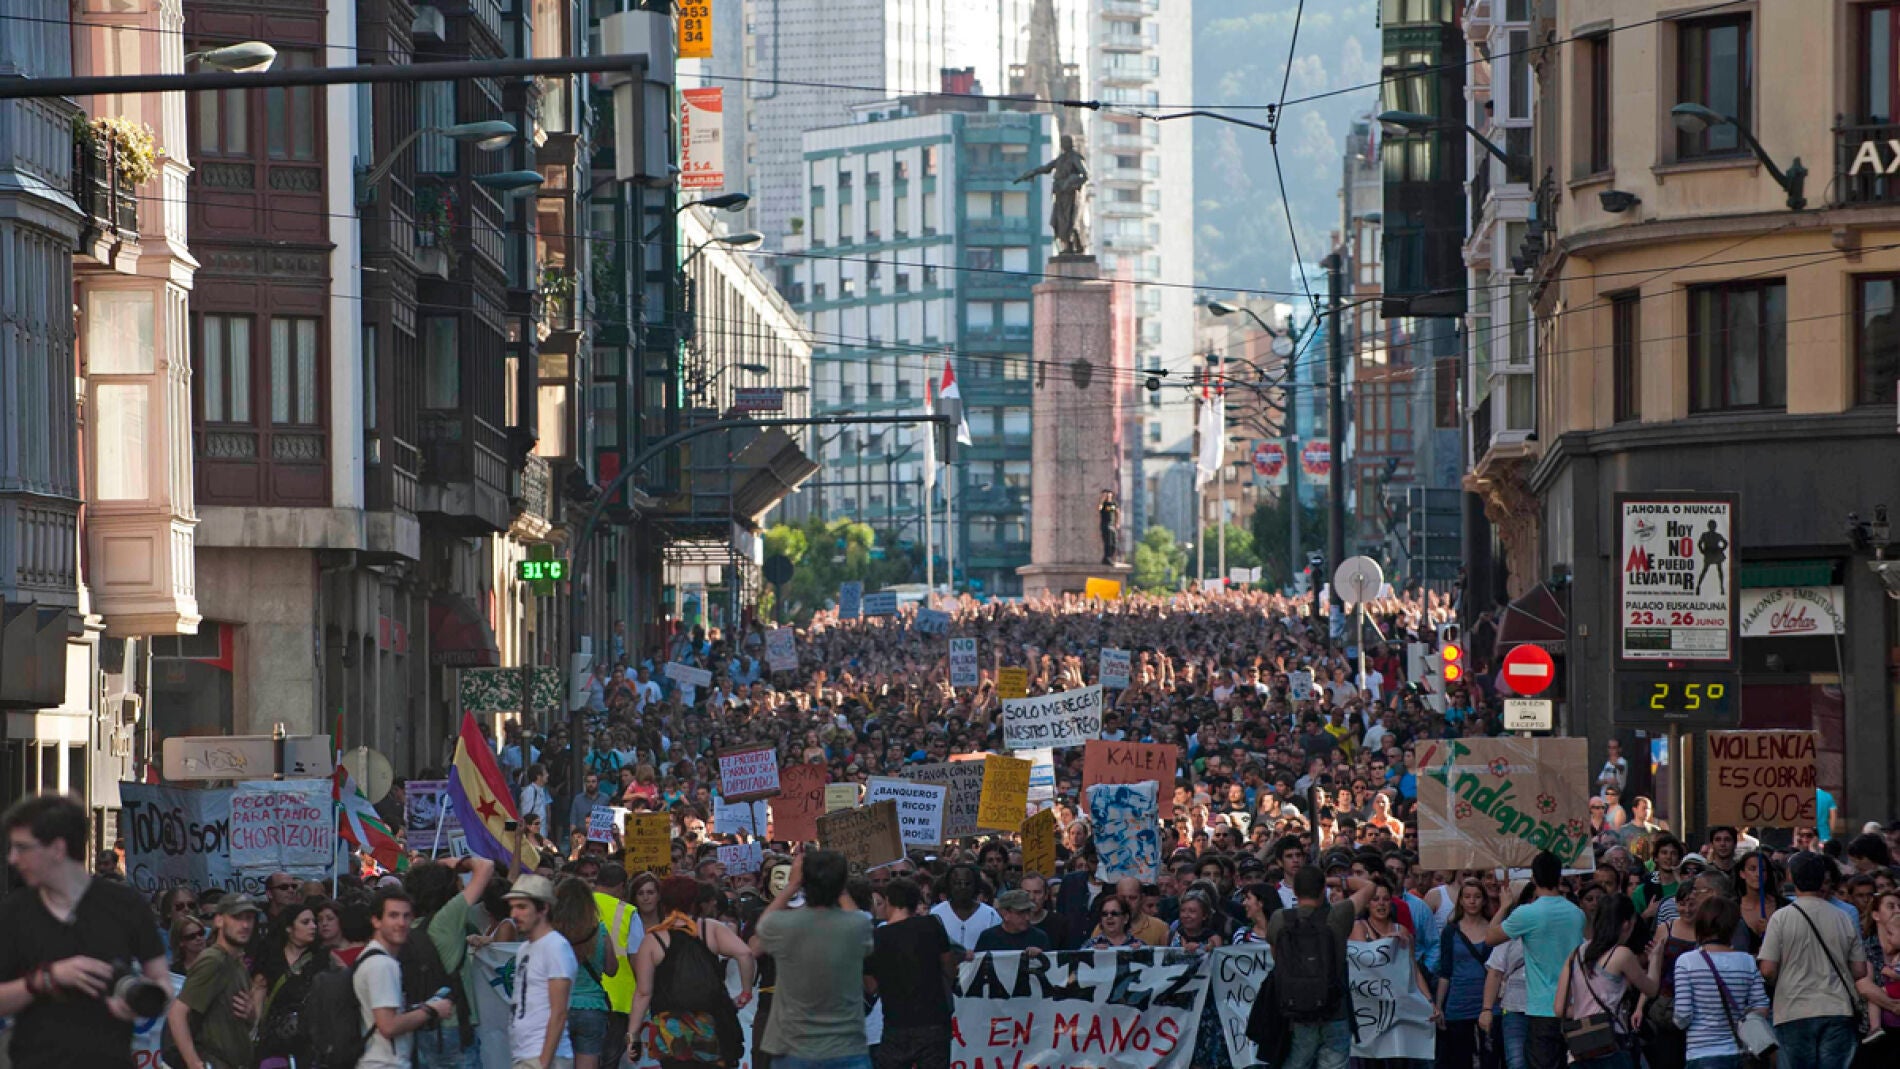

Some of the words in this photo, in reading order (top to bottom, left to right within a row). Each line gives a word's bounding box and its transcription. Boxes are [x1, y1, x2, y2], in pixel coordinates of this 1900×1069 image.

[685, 19, 702, 30] 81
[684, 32, 703, 42] 34
[1626, 505, 1669, 515] ¡AHORA
[1672, 505, 1680, 514] O
[1684, 505, 1726, 514] NUNCA!
[1669, 537, 1693, 558] NO
[1658, 559, 1694, 570] PUEDO
[1625, 602, 1664, 611] PALACIO
[1667, 602, 1727, 611] EUSKALDUNA
[1741, 589, 1783, 632] JAMONES
[1630, 611, 1654, 625] 23
[1671, 611, 1694, 626] 26
[1005, 704, 1039, 720] SOLO
[1709, 734, 1817, 760] VIOLENCIA
[1107, 747, 1168, 770] KALEA
[917, 767, 949, 781] FAVOR
[949, 764, 985, 777] CONSID
[1718, 766, 1749, 788] ES
[1753, 764, 1817, 788] COBRAR
[232, 795, 275, 809] POCO
[873, 787, 939, 799] ¿BANQUEROS
[902, 801, 937, 811] RICOS?
[1742, 792, 1816, 822] 600€
[232, 807, 271, 825] PARA
[274, 806, 321, 822] TANTO
[1220, 949, 1267, 983] CON
[1226, 984, 1257, 1008] NO
[987, 1011, 1035, 1048] EN
[1052, 1012, 1180, 1056] MANOS
[1229, 1016, 1248, 1056] B
